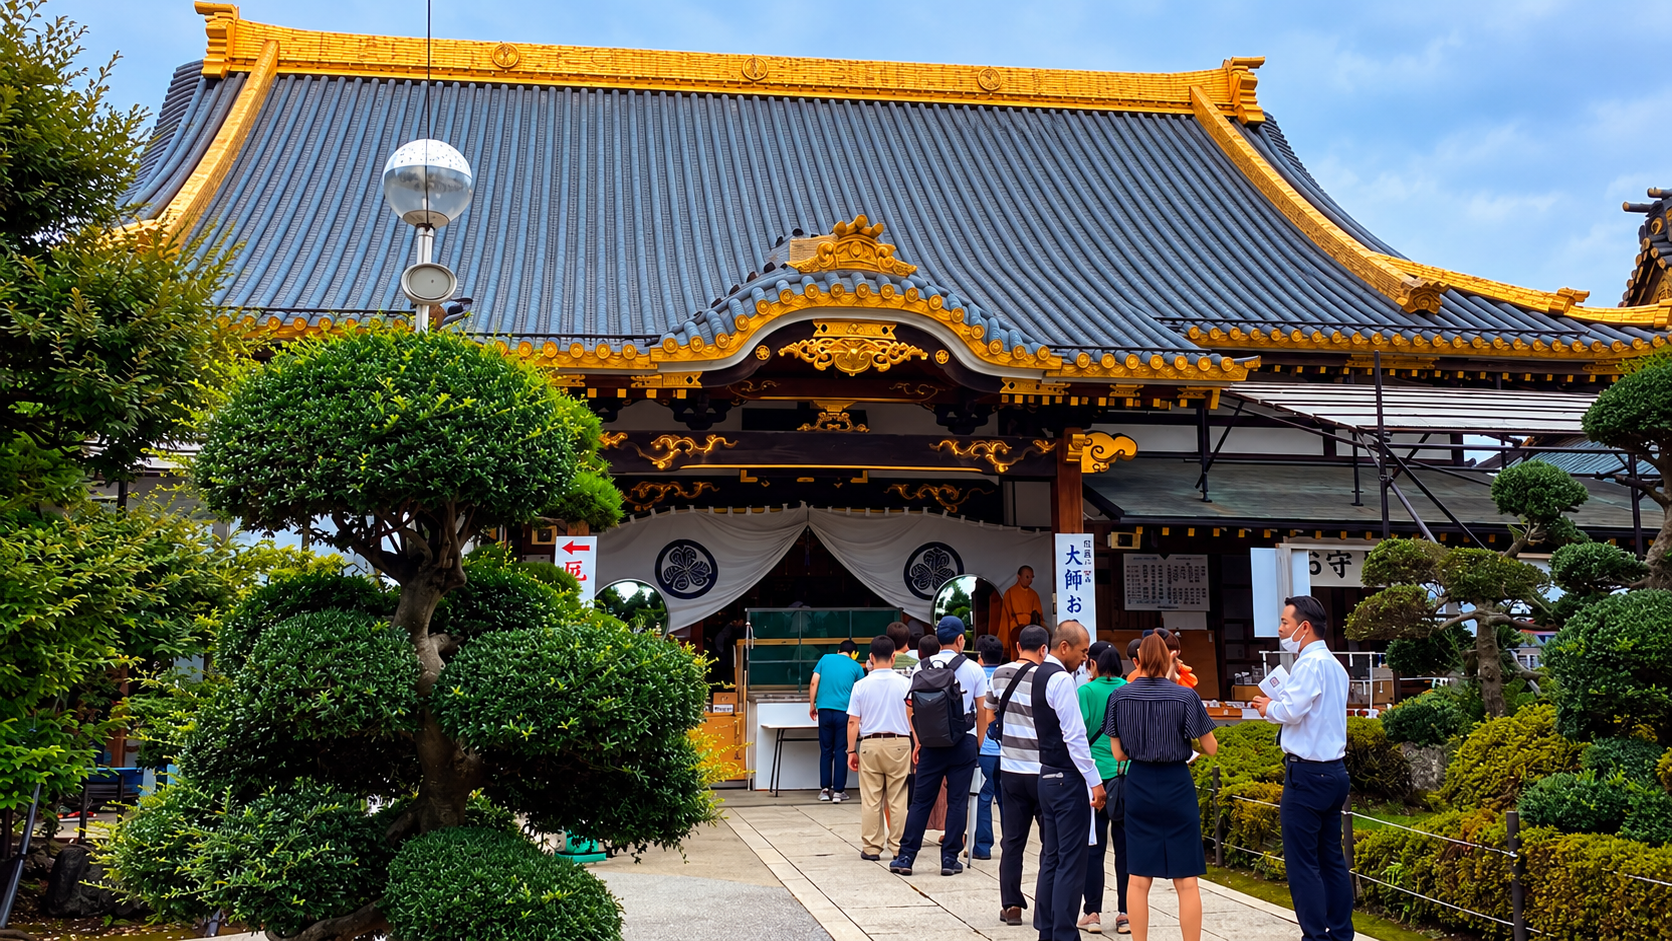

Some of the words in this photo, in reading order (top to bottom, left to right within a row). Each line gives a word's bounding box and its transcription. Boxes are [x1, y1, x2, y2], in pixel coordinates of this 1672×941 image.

[1065, 544, 1083, 623] 大師お
[1309, 550, 1371, 579] お守
